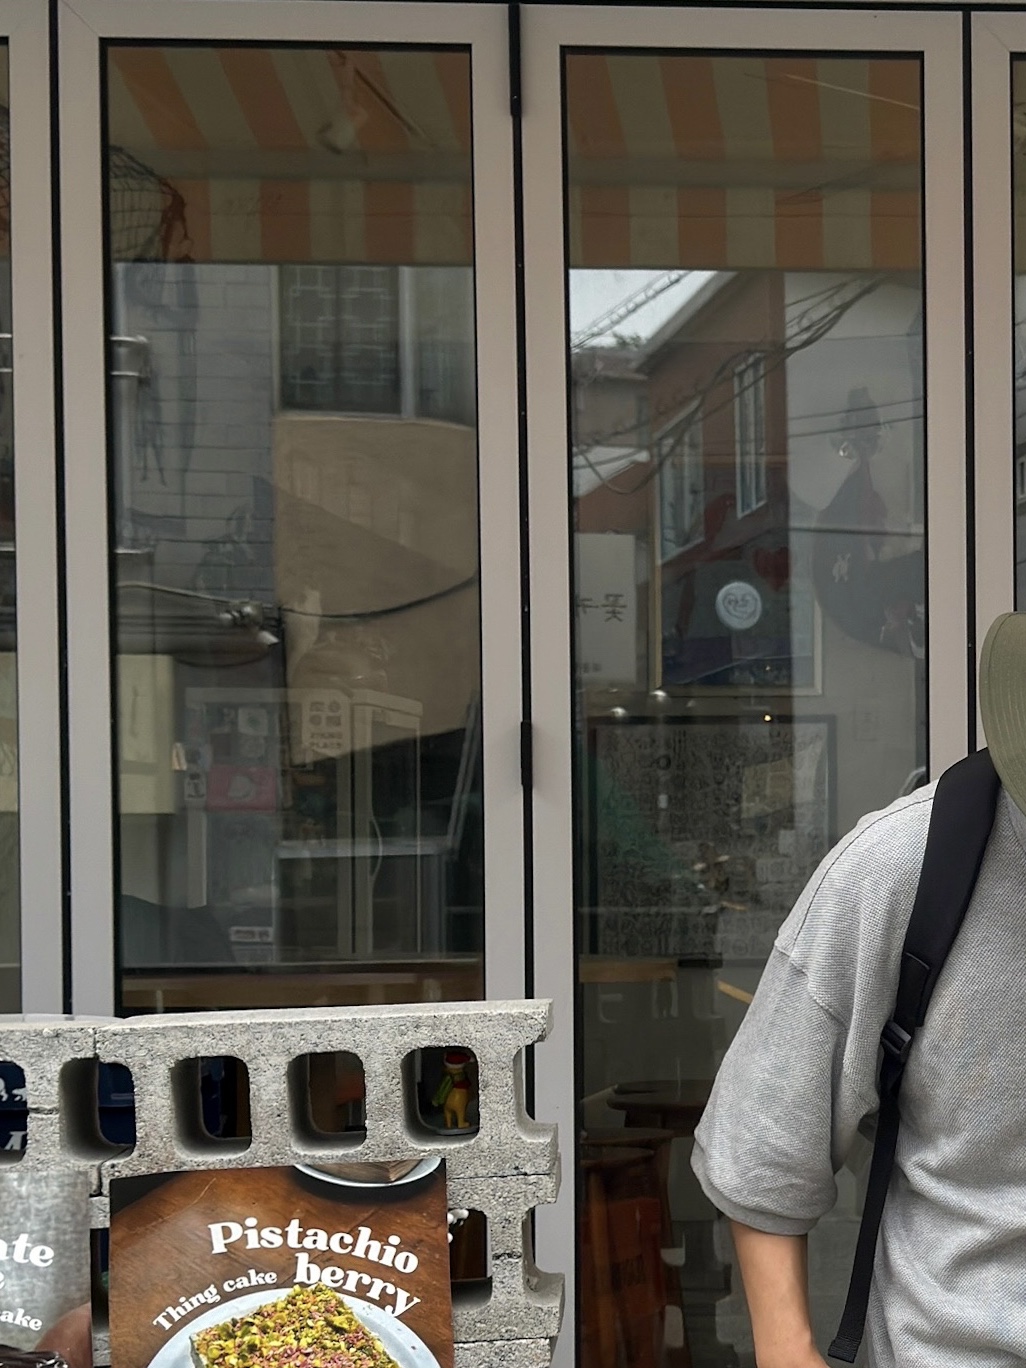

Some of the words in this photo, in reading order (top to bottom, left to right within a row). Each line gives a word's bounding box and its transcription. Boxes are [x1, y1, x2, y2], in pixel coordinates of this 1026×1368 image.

[207, 1216, 419, 1274] Pistachio
[152, 1283, 221, 1332] Thing
[223, 1268, 278, 1293] cake
[293, 1252, 421, 1317] berry
[0, 1308, 42, 1331] ake
